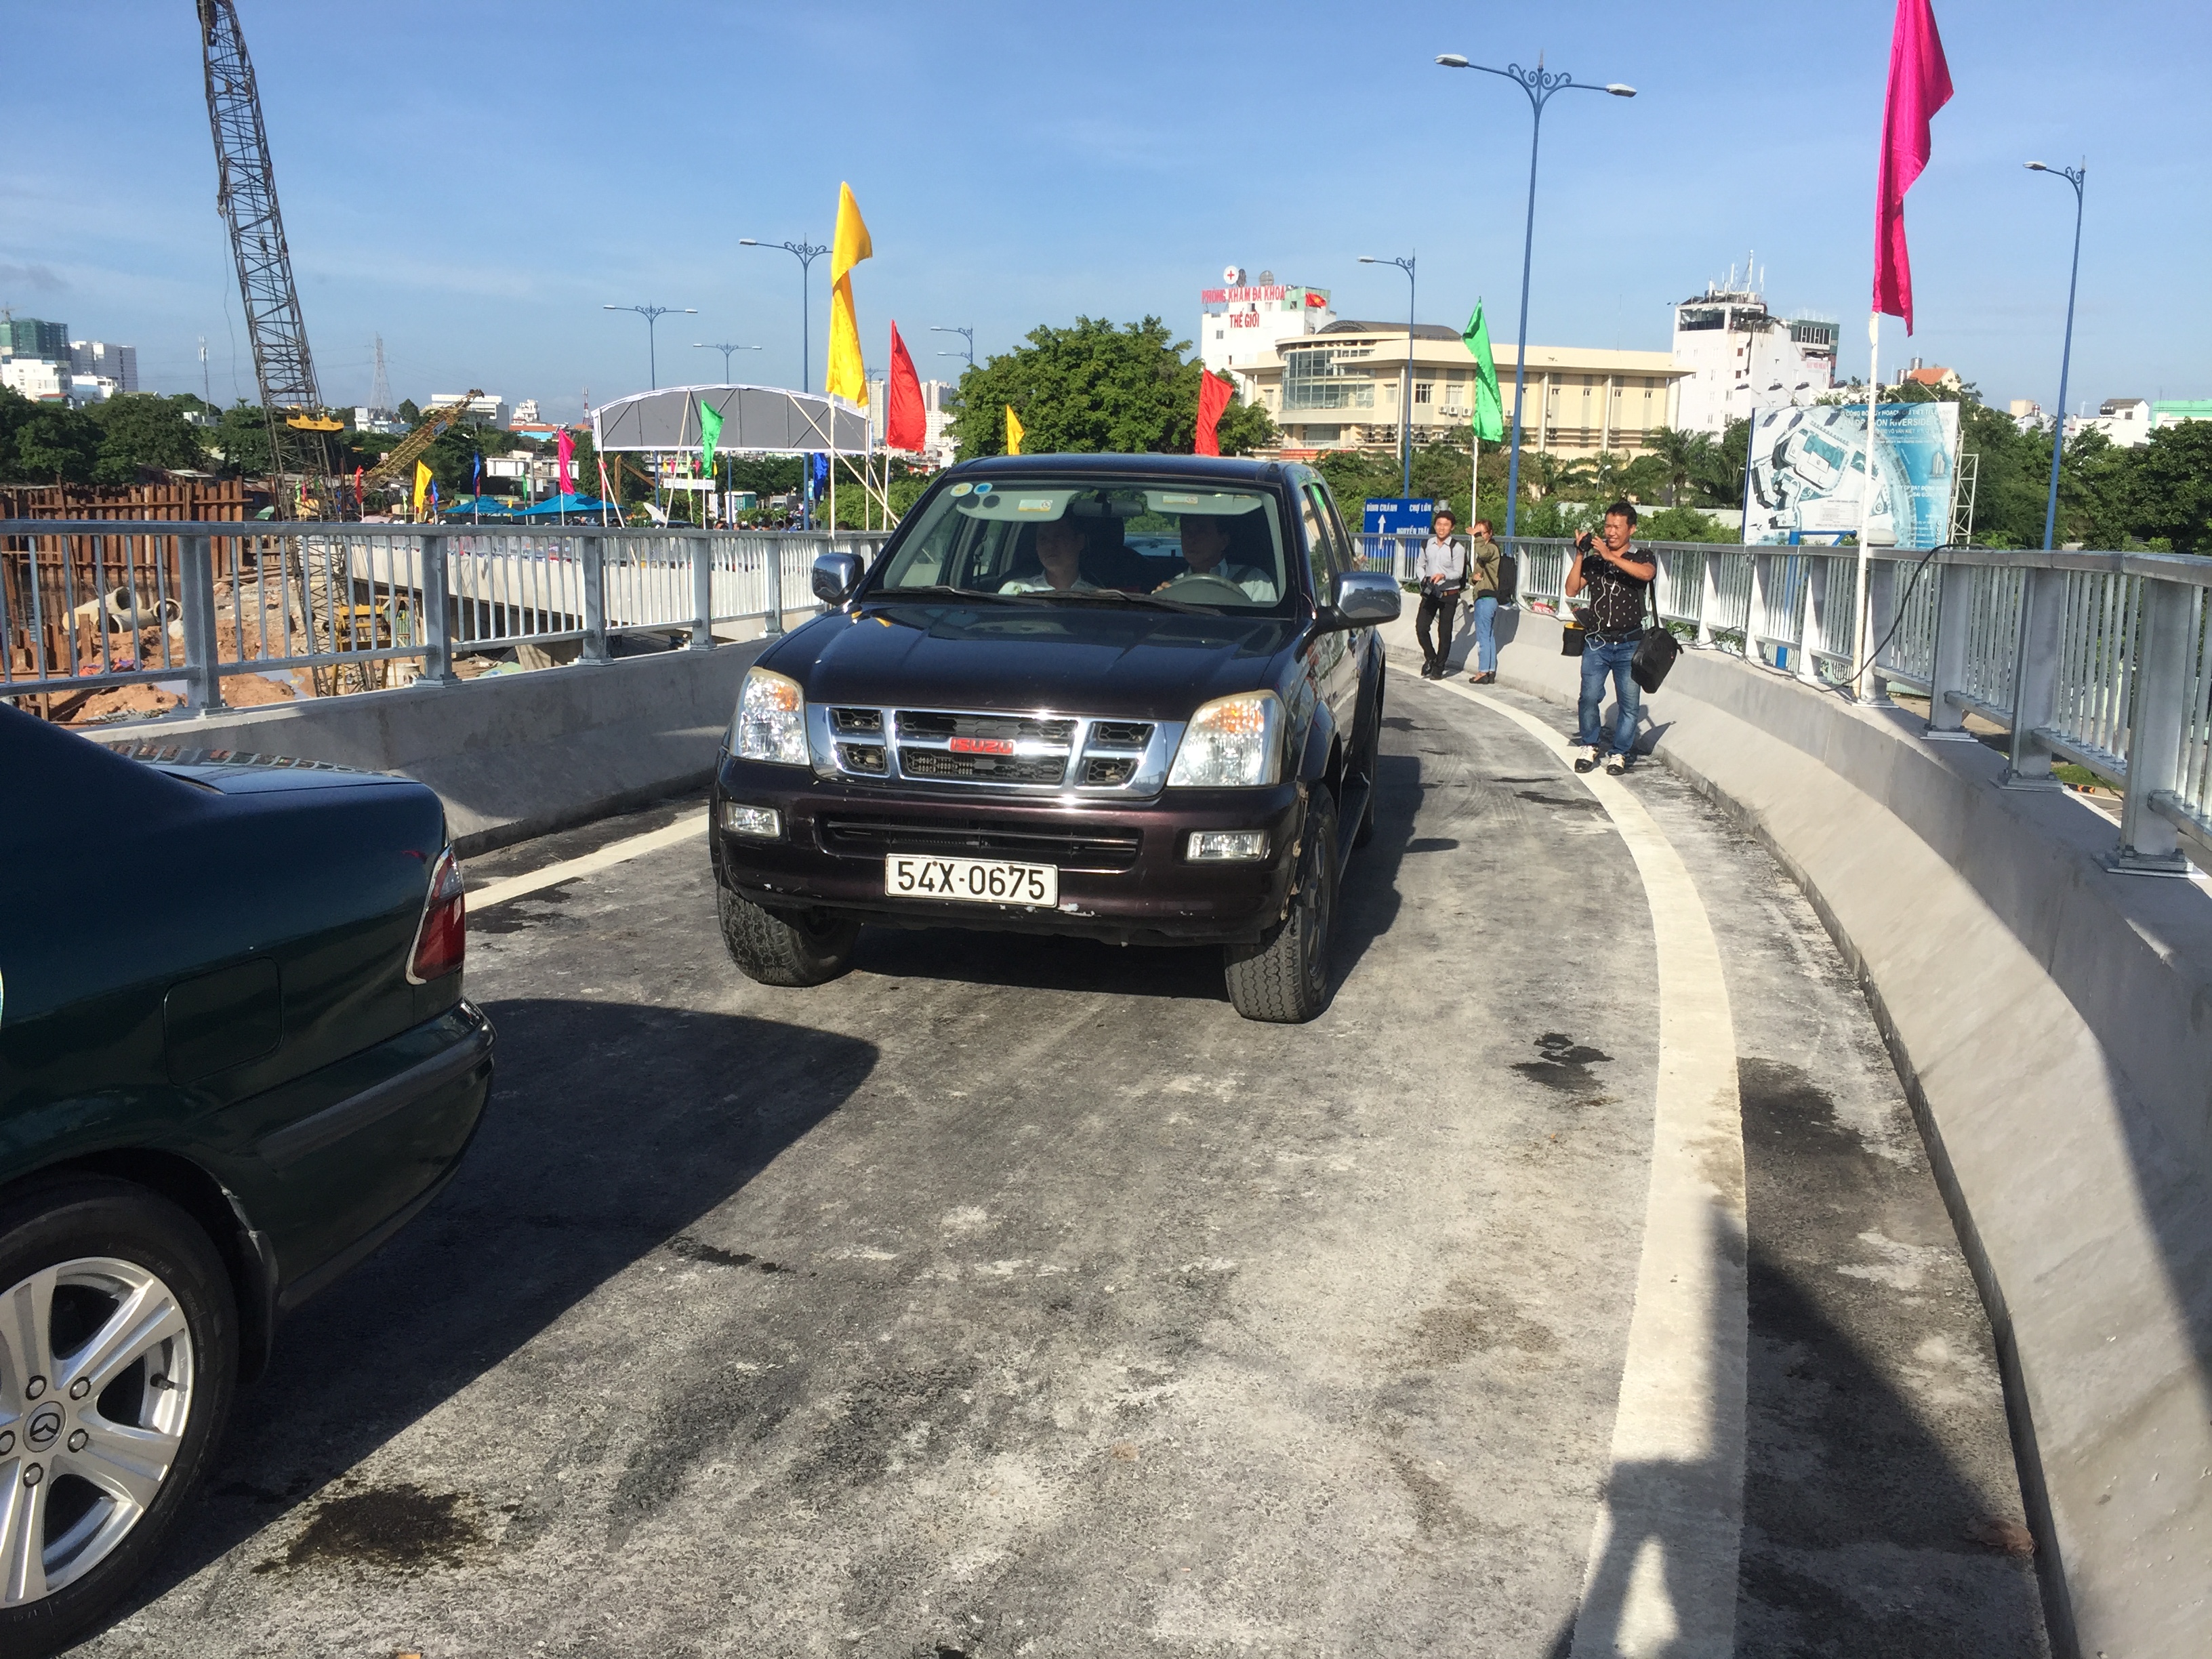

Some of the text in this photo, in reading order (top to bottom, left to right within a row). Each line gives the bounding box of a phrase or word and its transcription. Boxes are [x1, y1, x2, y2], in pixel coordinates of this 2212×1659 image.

[1252, 287, 1262, 301] ĐA
[1265, 285, 1286, 300] KHOA
[1229, 308, 1244, 328] THẾ
[1889, 418, 1931, 427] RIVERSIDE
[1380, 503, 1397, 512] CHÁNH
[1410, 503, 1420, 514] CHỢ
[951, 738, 1012, 754] ISUZU
[898, 861, 1044, 900] 54X-0675
